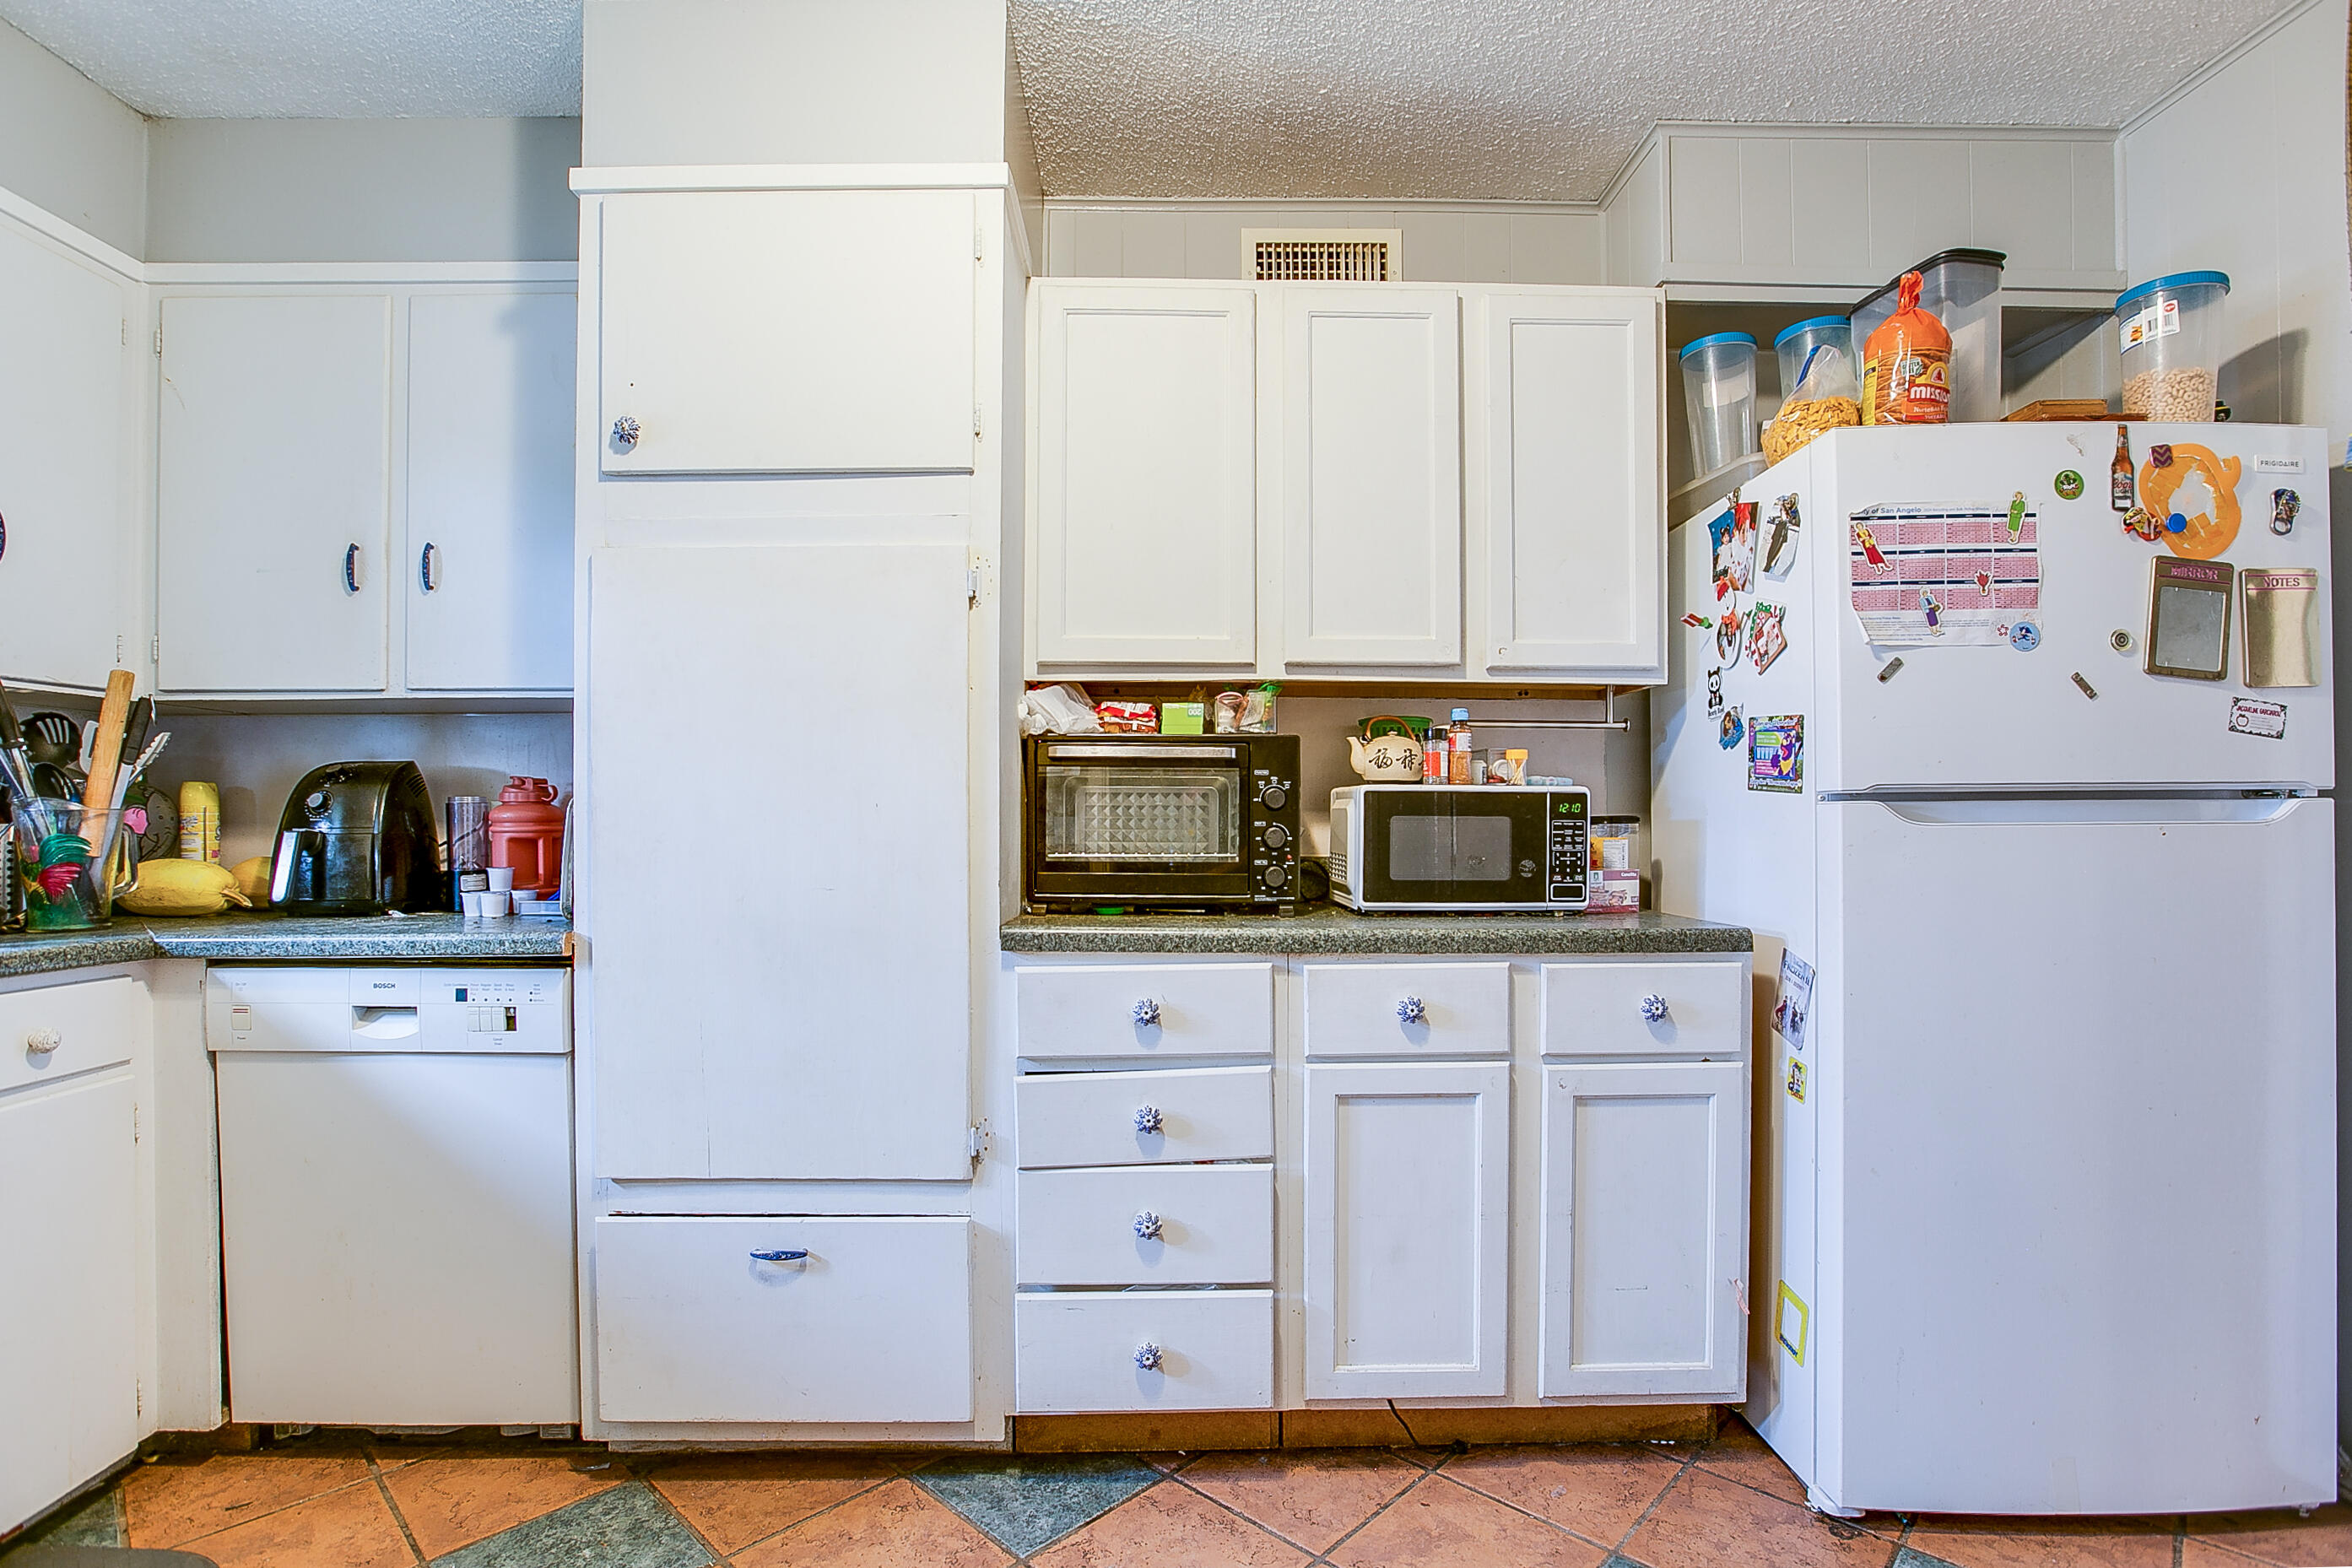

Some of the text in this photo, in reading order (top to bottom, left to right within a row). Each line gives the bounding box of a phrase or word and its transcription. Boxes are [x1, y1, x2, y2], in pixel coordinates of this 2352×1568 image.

[2171, 566, 2219, 581] MIRROR
[2263, 577, 2301, 588] NOTES
[1782, 960, 1805, 981] FROZEN
